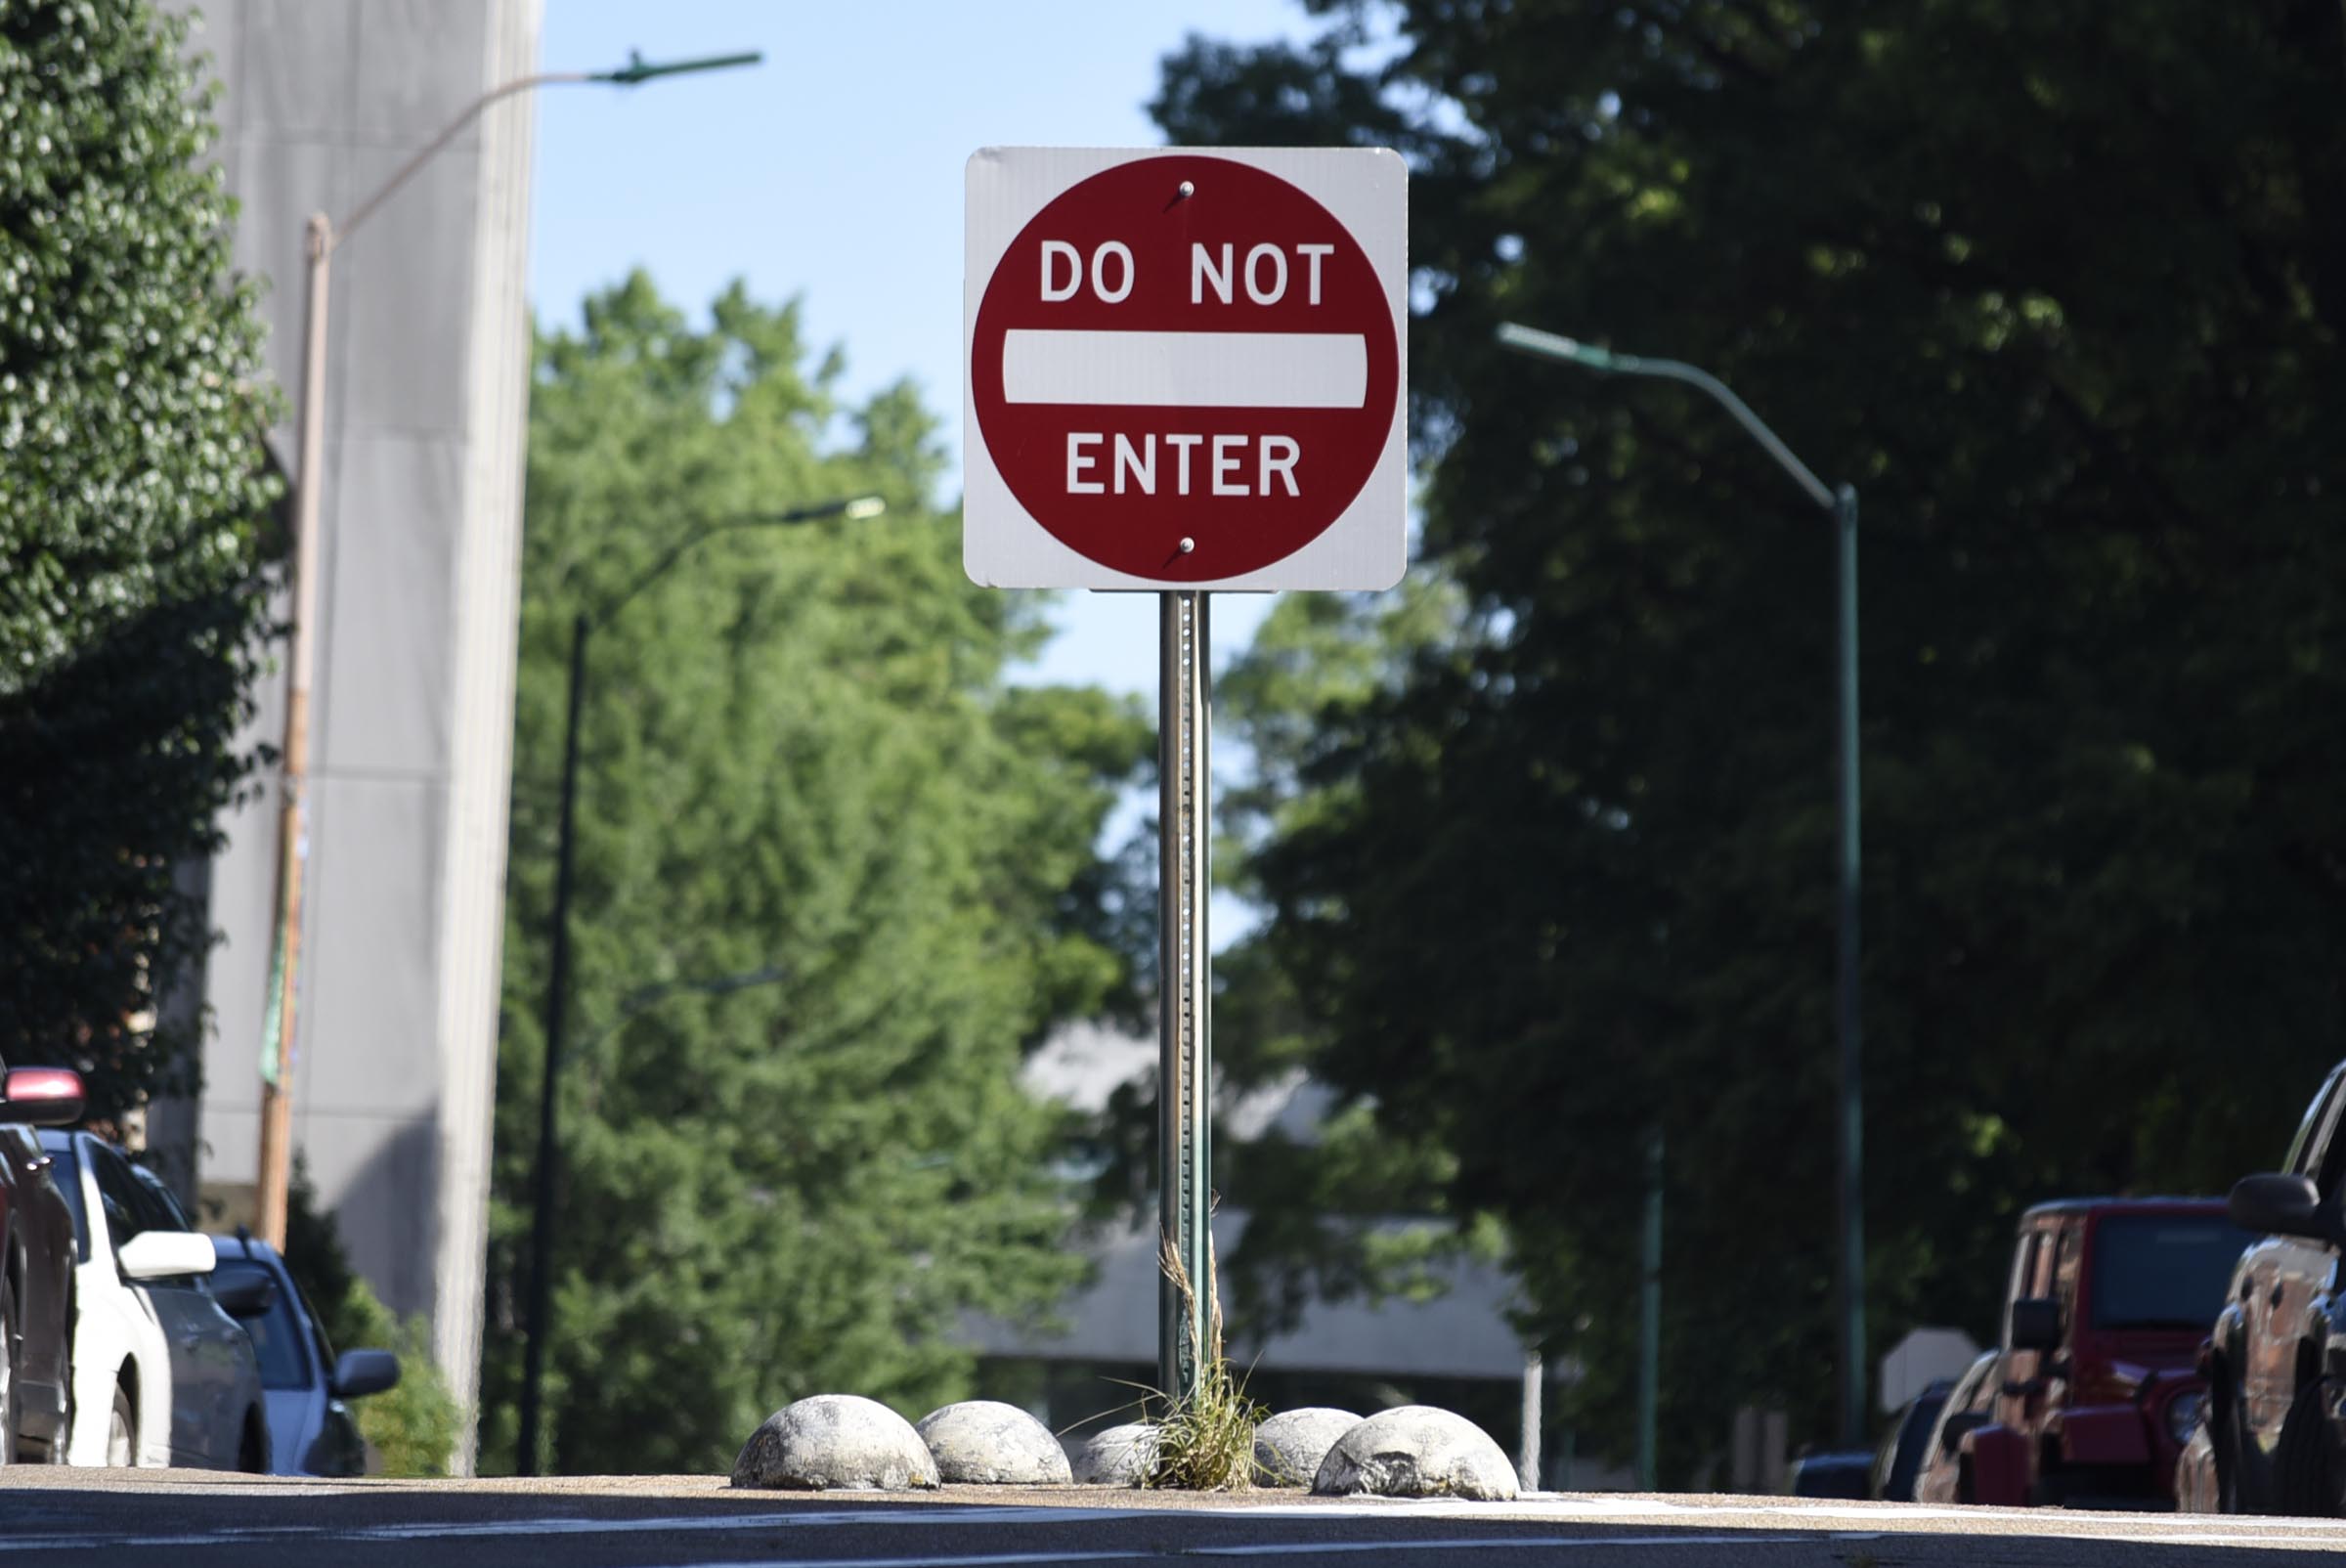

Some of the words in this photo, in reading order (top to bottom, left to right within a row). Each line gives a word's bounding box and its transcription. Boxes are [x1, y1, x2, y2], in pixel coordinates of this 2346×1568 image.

[1040, 240, 1135, 304] DO
[1191, 242, 1334, 306] NOT
[1065, 431, 1301, 498] ENTER
